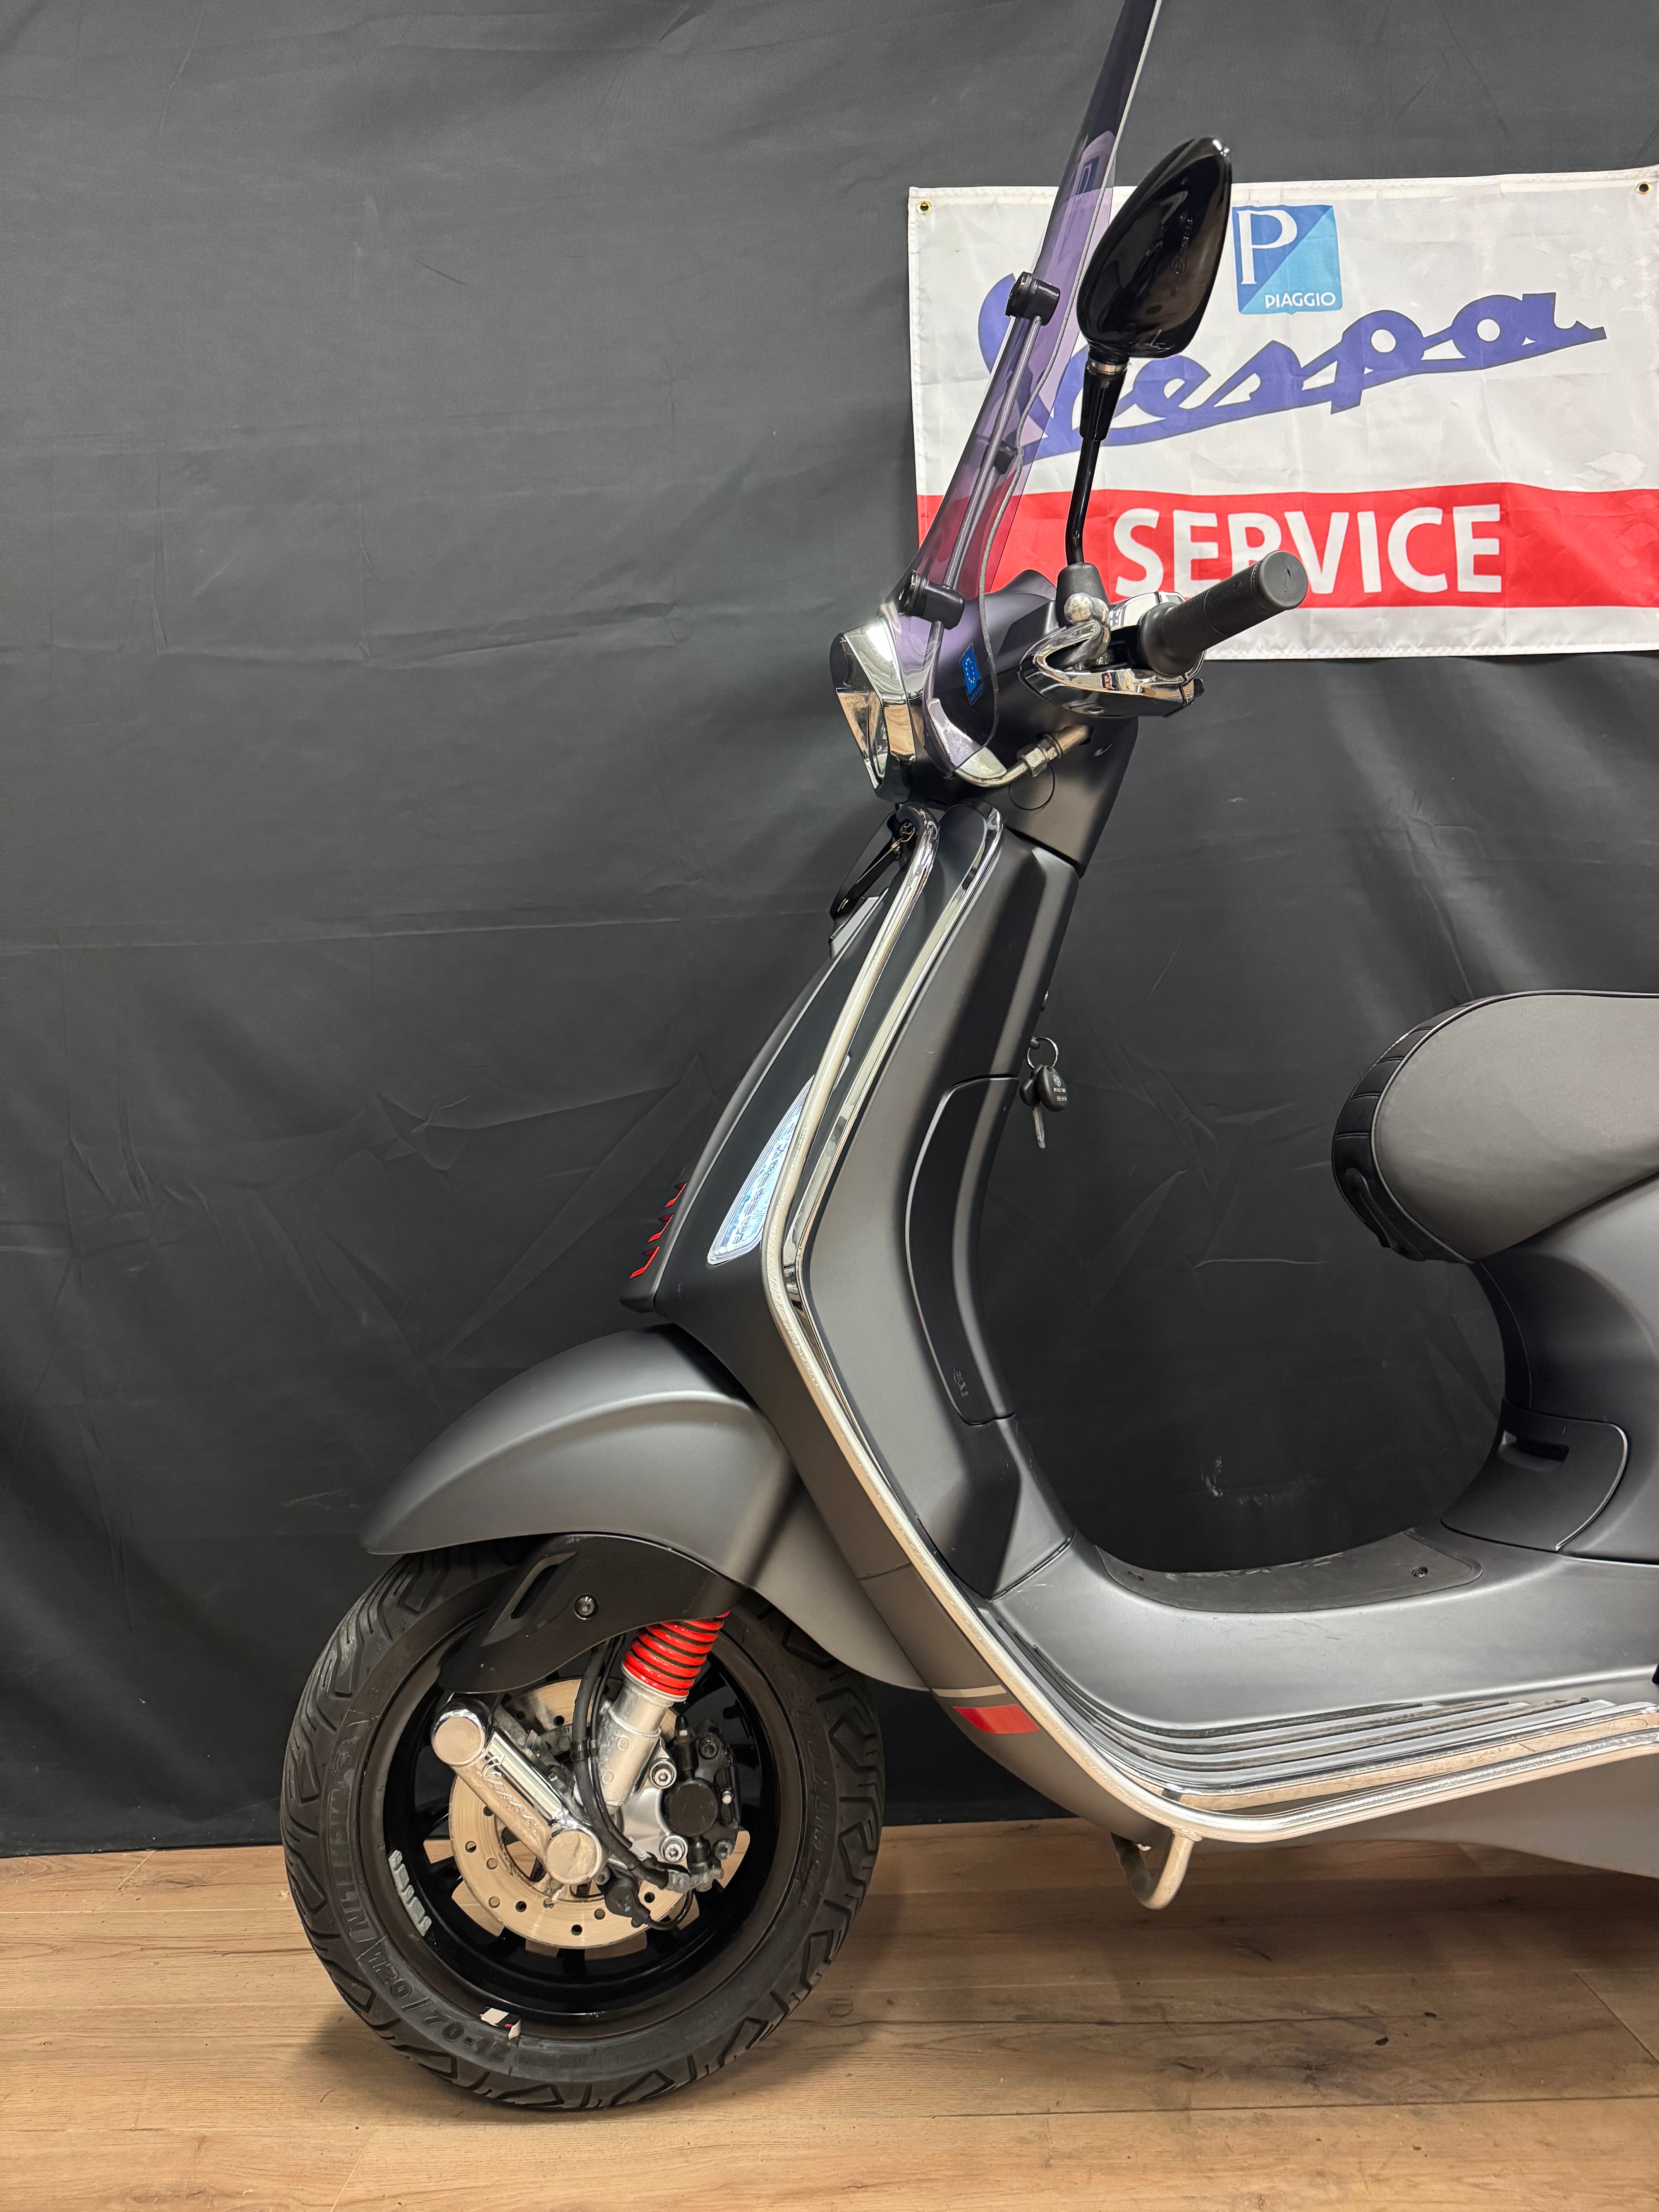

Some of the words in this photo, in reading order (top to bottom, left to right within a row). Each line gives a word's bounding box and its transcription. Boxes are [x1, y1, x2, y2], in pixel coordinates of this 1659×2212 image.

[1237, 210, 1297, 285] P
[1264, 292, 1336, 309] PIAGGIO
[978, 272, 1607, 465] Vespa
